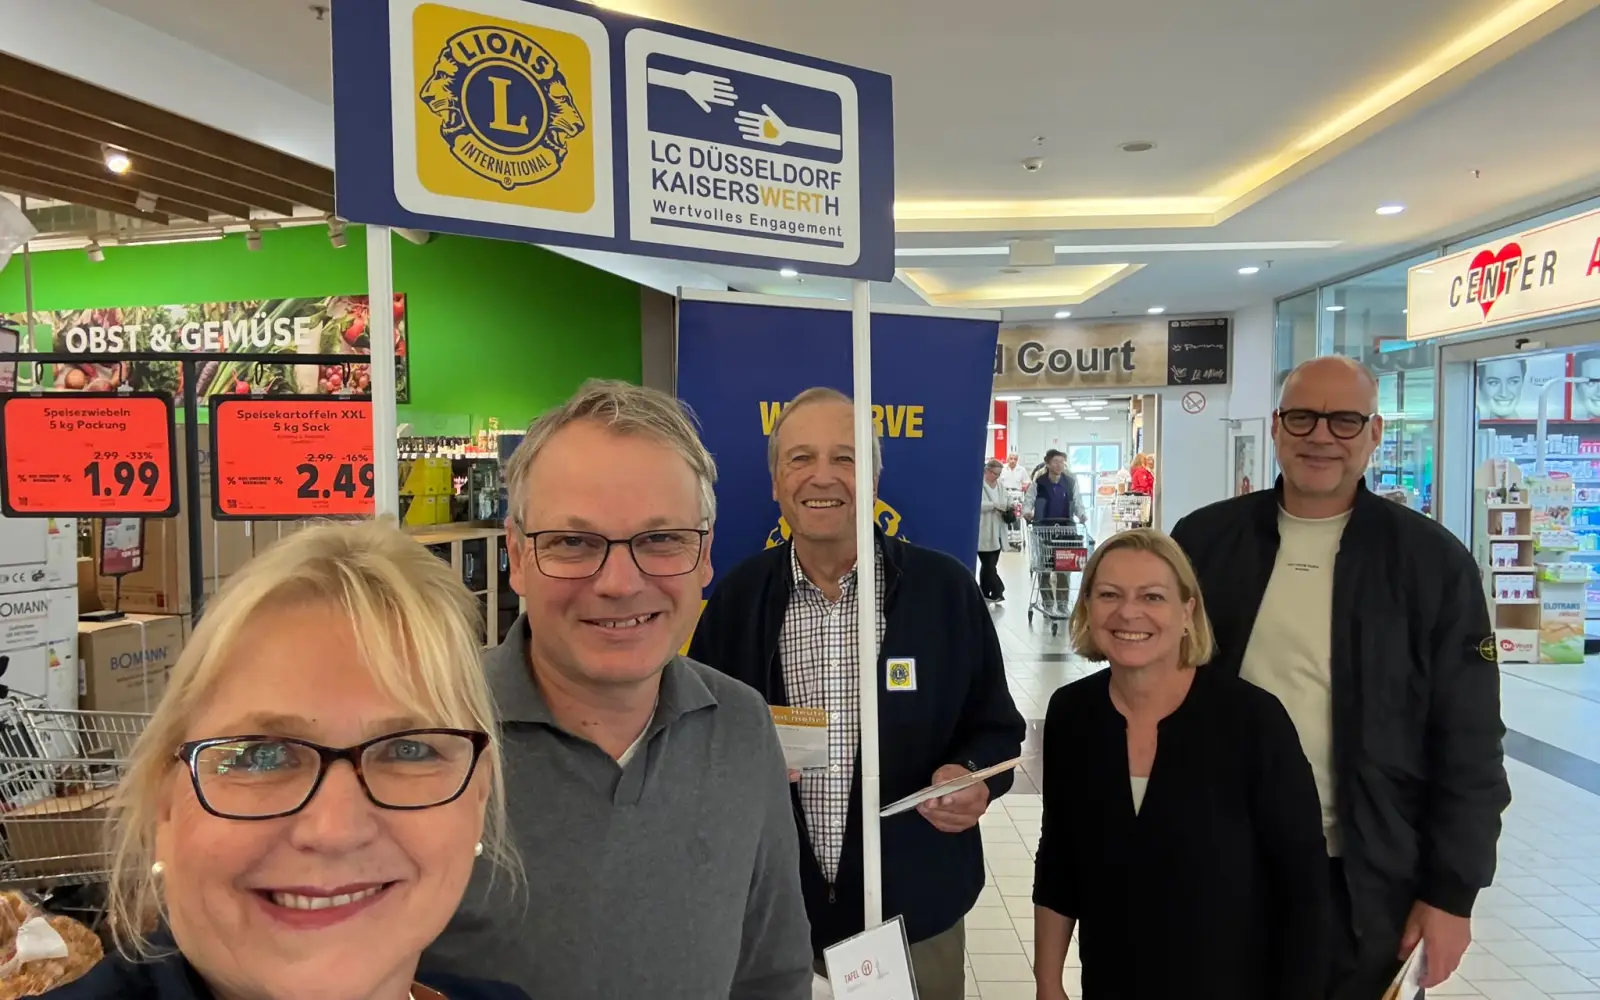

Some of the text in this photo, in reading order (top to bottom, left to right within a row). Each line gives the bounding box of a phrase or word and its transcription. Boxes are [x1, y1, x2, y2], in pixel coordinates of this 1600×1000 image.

[456, 33, 549, 75] LIONS
[488, 76, 529, 135] L
[460, 140, 552, 177] INTERNATIONAL
[651, 139, 842, 191] LC DÜSSELDORF
[652, 168, 839, 217] KAISERSWERTH
[652, 199, 843, 237] Wertvolles Engagement
[1449, 250, 1557, 308] CENTER
[65, 311, 311, 353] OBST & GEMÜSE
[1017, 340, 1136, 374] Court
[43, 407, 131, 419] Speisezwiebeln
[50, 420, 126, 431] 5 kg Packung
[237, 409, 366, 421] Speisekartoffeln XXL
[273, 422, 331, 433] 5 kg Sack
[871, 405, 924, 438] RVE
[94, 451, 153, 460] 2.99 -33%
[307, 453, 368, 462] 2.99 -16%
[84, 461, 160, 497] 1.99
[296, 463, 375, 499] 2.49
[0, 600, 49, 618] OMANN
[844, 970, 860, 984] TAFEL
